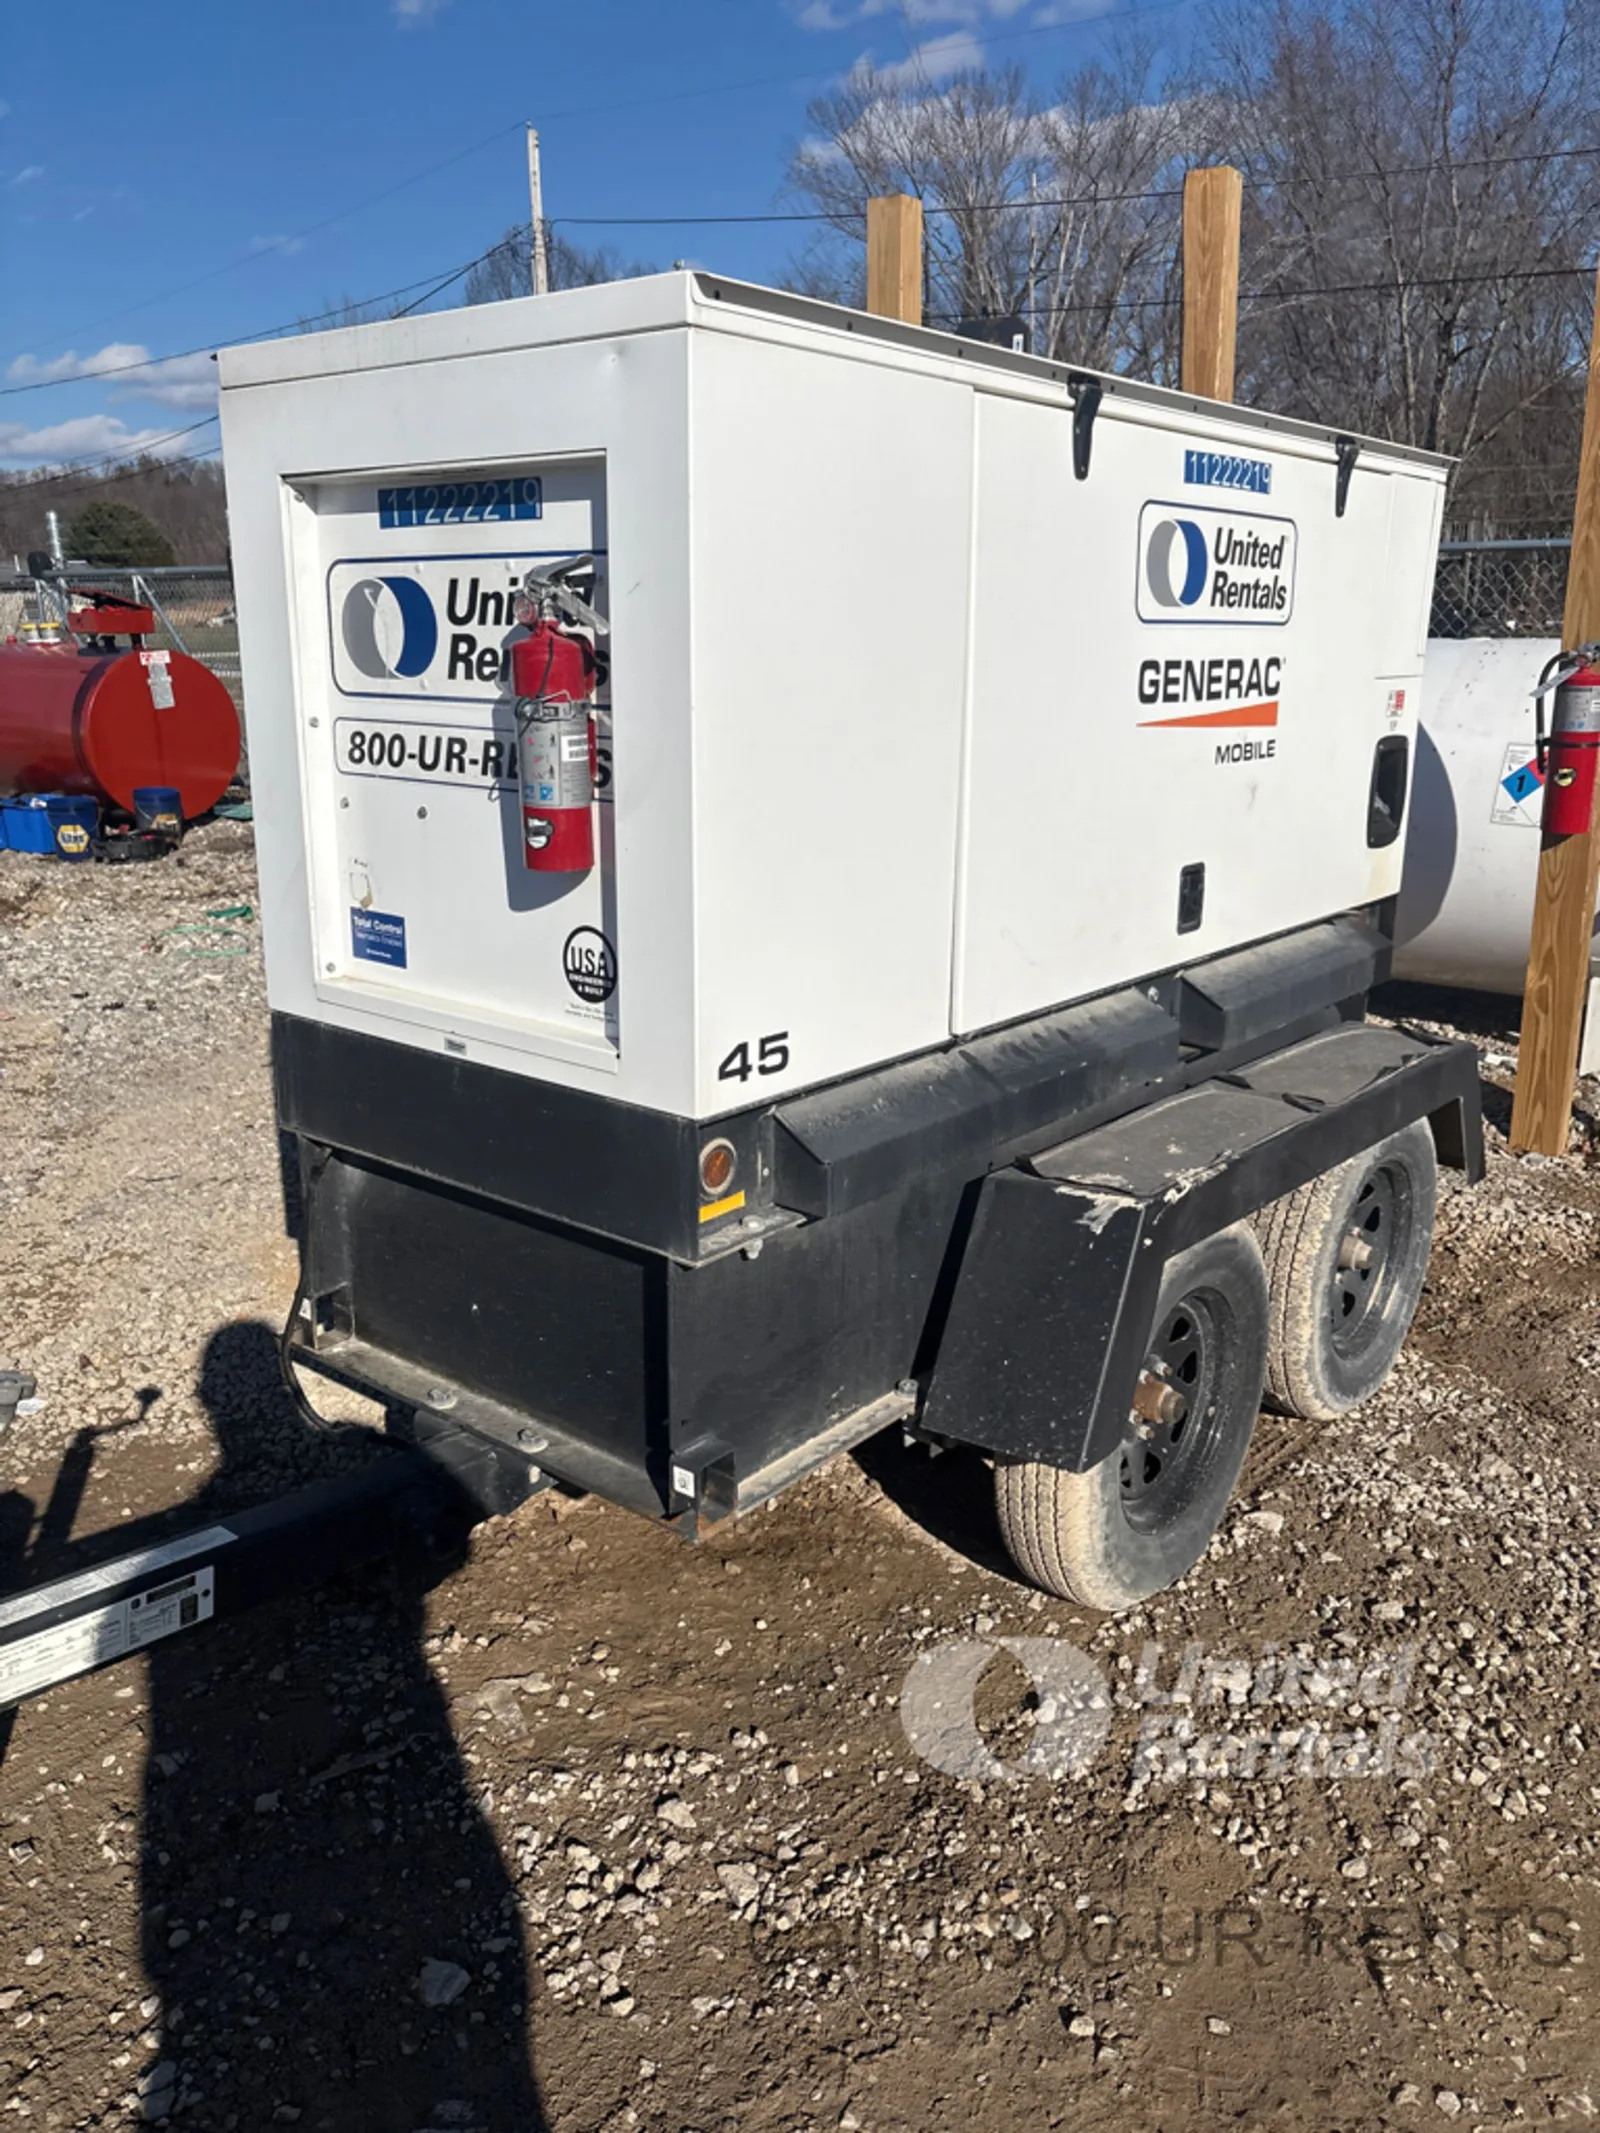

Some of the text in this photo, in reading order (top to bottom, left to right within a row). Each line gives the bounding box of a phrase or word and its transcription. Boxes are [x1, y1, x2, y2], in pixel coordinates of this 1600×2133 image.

[387, 478, 541, 527] 11222219
[1213, 527, 1286, 570] United
[1210, 570, 1288, 611] Rentals
[1138, 656, 1282, 705] GENERAC
[1214, 739, 1276, 765] MOBILE
[1516, 773, 1527, 793] 1
[571, 945, 609, 978] USA
[718, 1031, 790, 1083] 45
